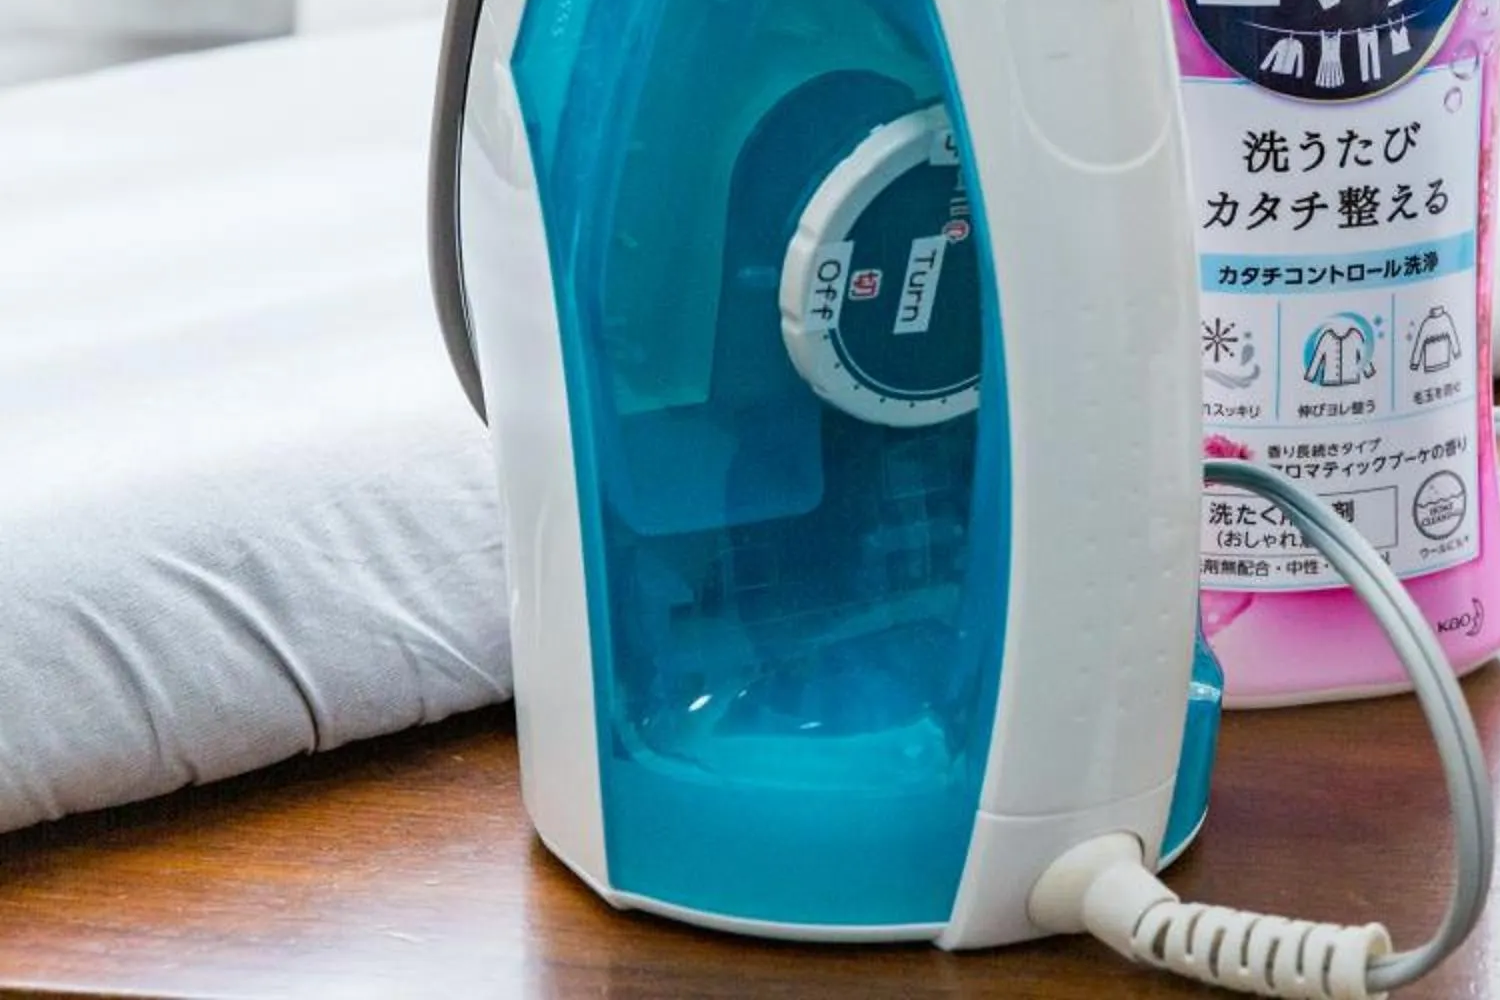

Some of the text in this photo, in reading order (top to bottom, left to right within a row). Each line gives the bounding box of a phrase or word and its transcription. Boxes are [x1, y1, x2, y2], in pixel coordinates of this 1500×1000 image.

[1242, 121, 1421, 173] 洗うたび
[1202, 178, 1449, 231] カタチ整える
[901, 248, 937, 323] Turn
[1218, 251, 1439, 286] カタチコントロール洗浄
